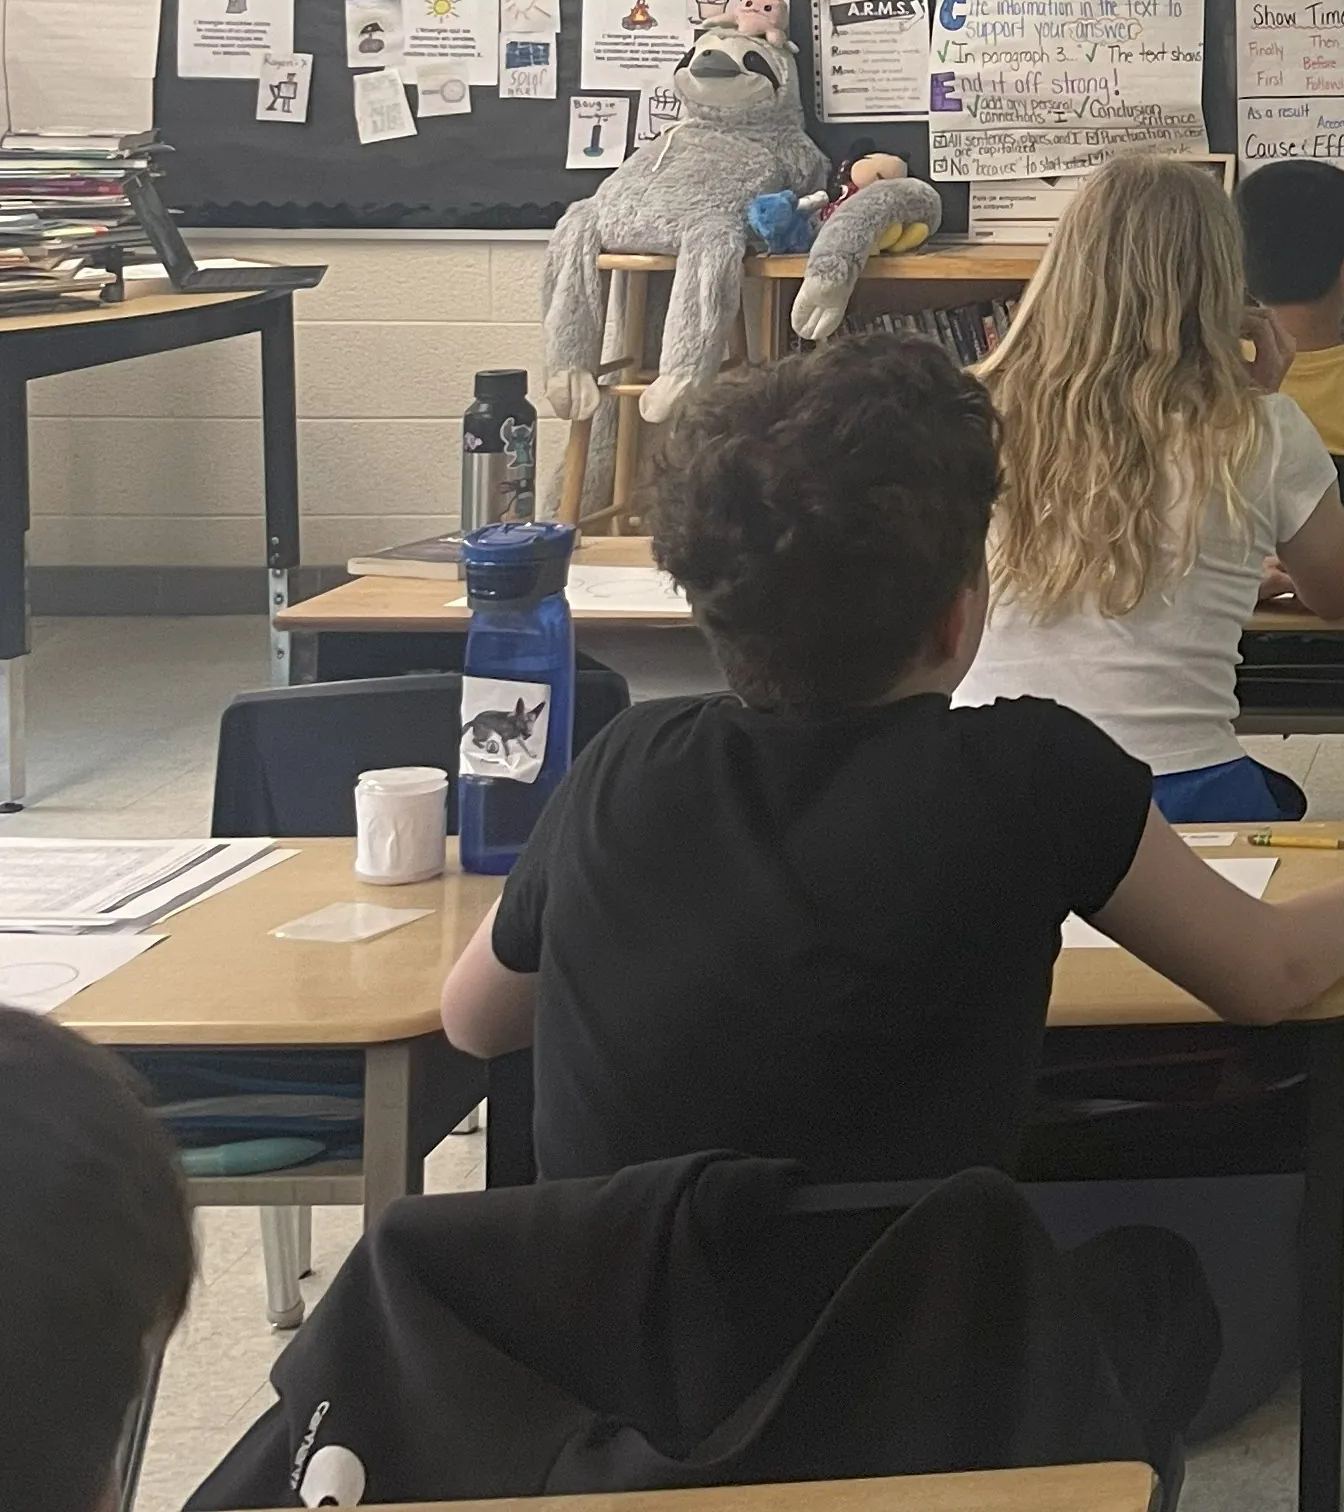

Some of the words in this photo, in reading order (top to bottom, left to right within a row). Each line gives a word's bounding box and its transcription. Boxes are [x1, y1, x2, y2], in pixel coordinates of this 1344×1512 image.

[1253, 2, 1297, 27] Show
[965, 18, 1025, 45] support
[1248, 40, 1284, 61] Finally
[1015, 72, 1043, 94] off
[1090, 99, 1162, 119] Conclusion
[1244, 133, 1298, 159] Cause
